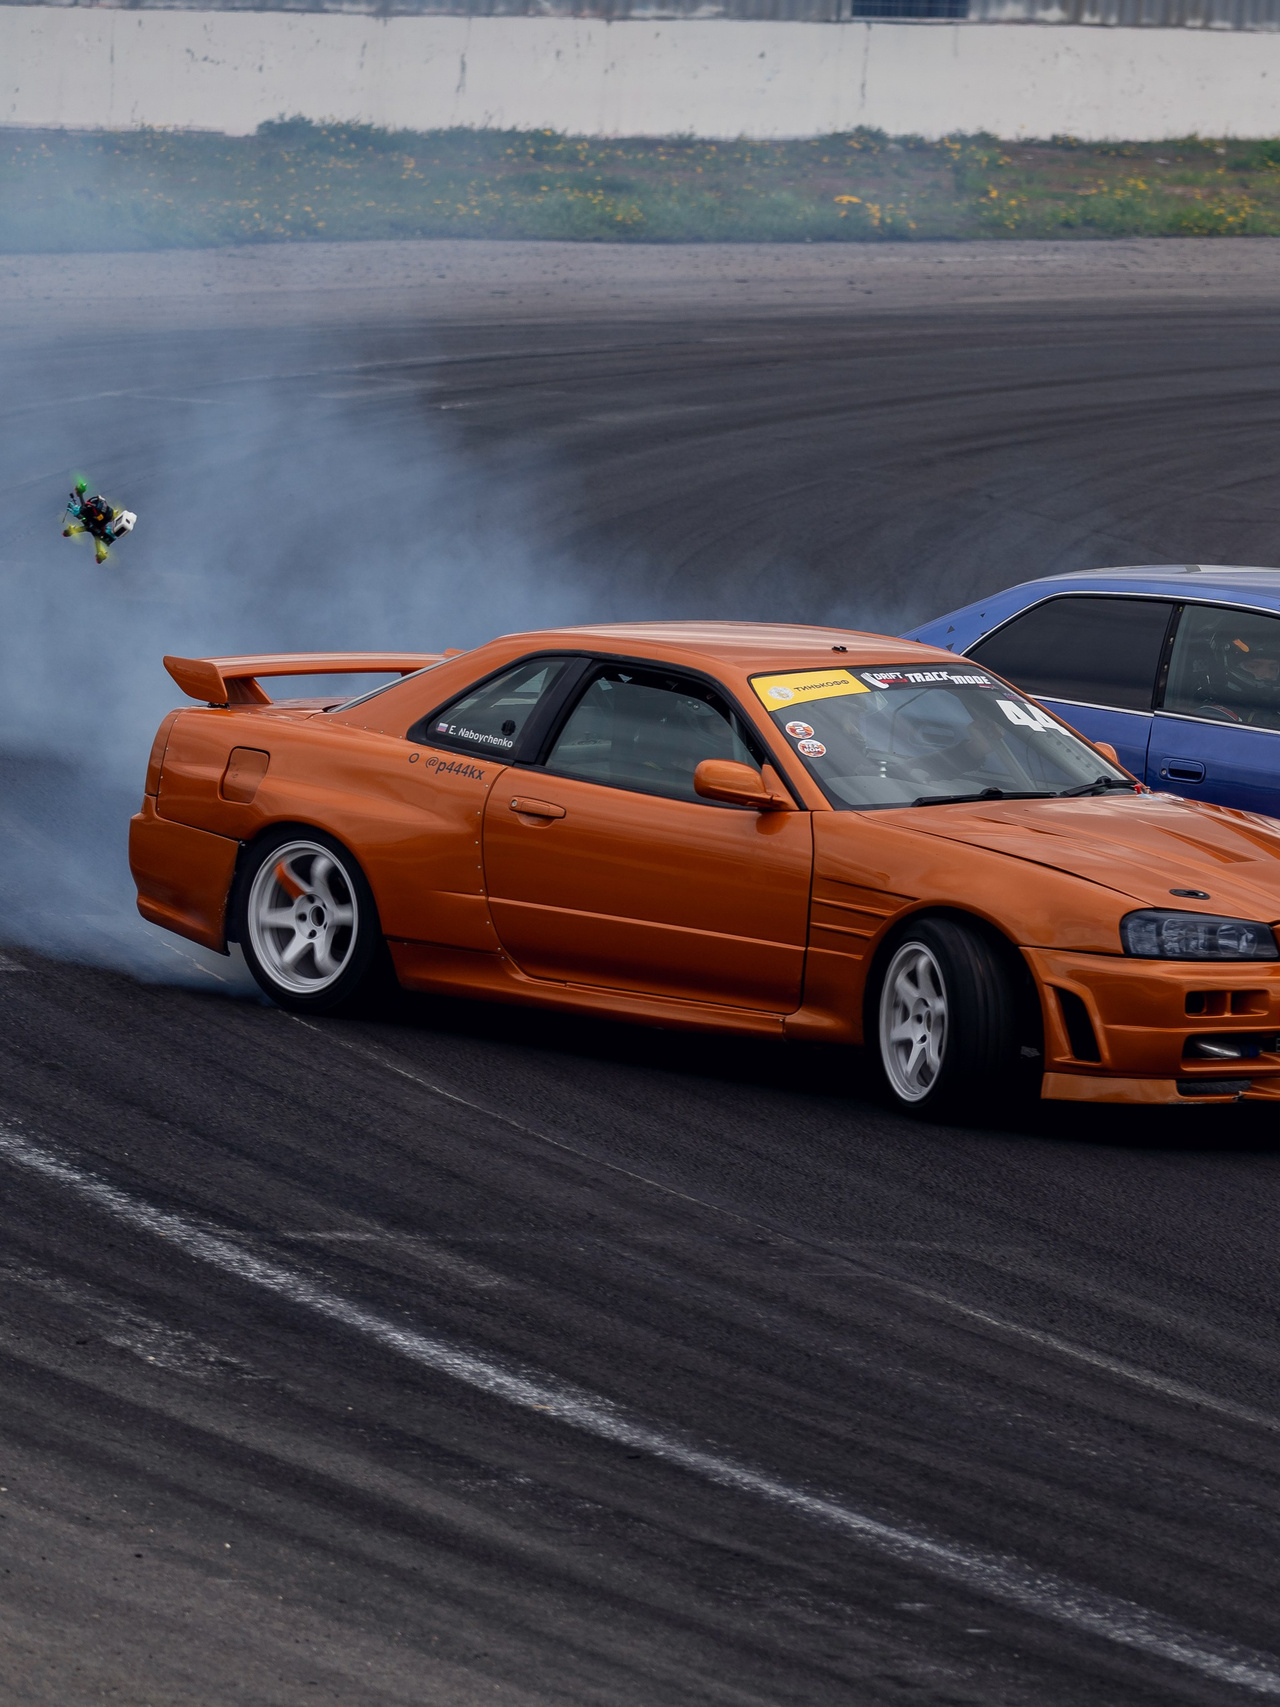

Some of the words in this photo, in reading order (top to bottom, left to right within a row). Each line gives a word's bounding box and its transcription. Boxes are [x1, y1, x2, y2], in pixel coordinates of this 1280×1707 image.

[793, 679, 850, 693] ТИНЬКОФФ
[872, 672, 903, 680] DRIFT
[995, 699, 1074, 738] 44
[448, 725, 457, 735] E.
[459, 727, 513, 748] Naboychenko
[425, 756, 485, 780] @p444kx
